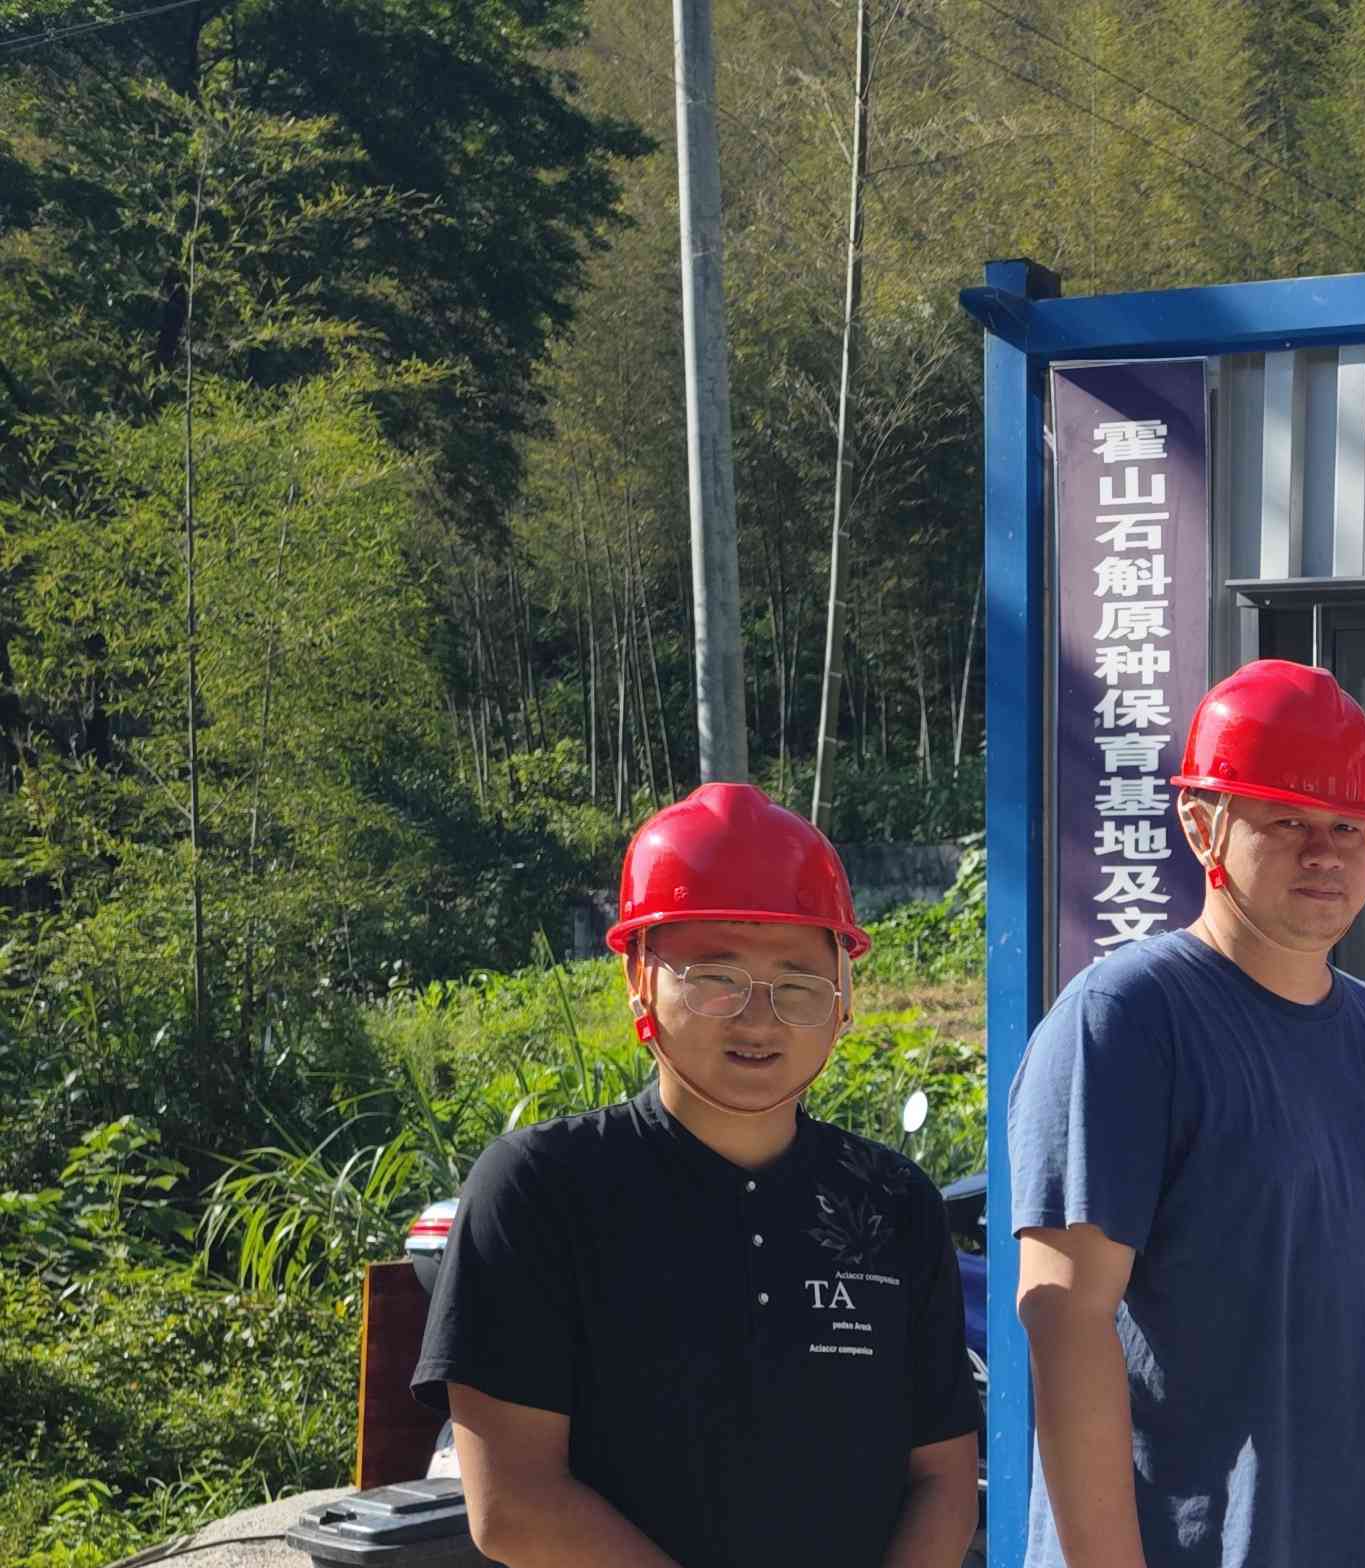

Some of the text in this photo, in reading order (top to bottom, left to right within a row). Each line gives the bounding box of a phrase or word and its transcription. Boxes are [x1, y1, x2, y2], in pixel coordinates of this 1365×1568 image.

[1093, 419, 1172, 964] 霍山石斛原种保育基地及文
[804, 1280, 856, 1310] TA
